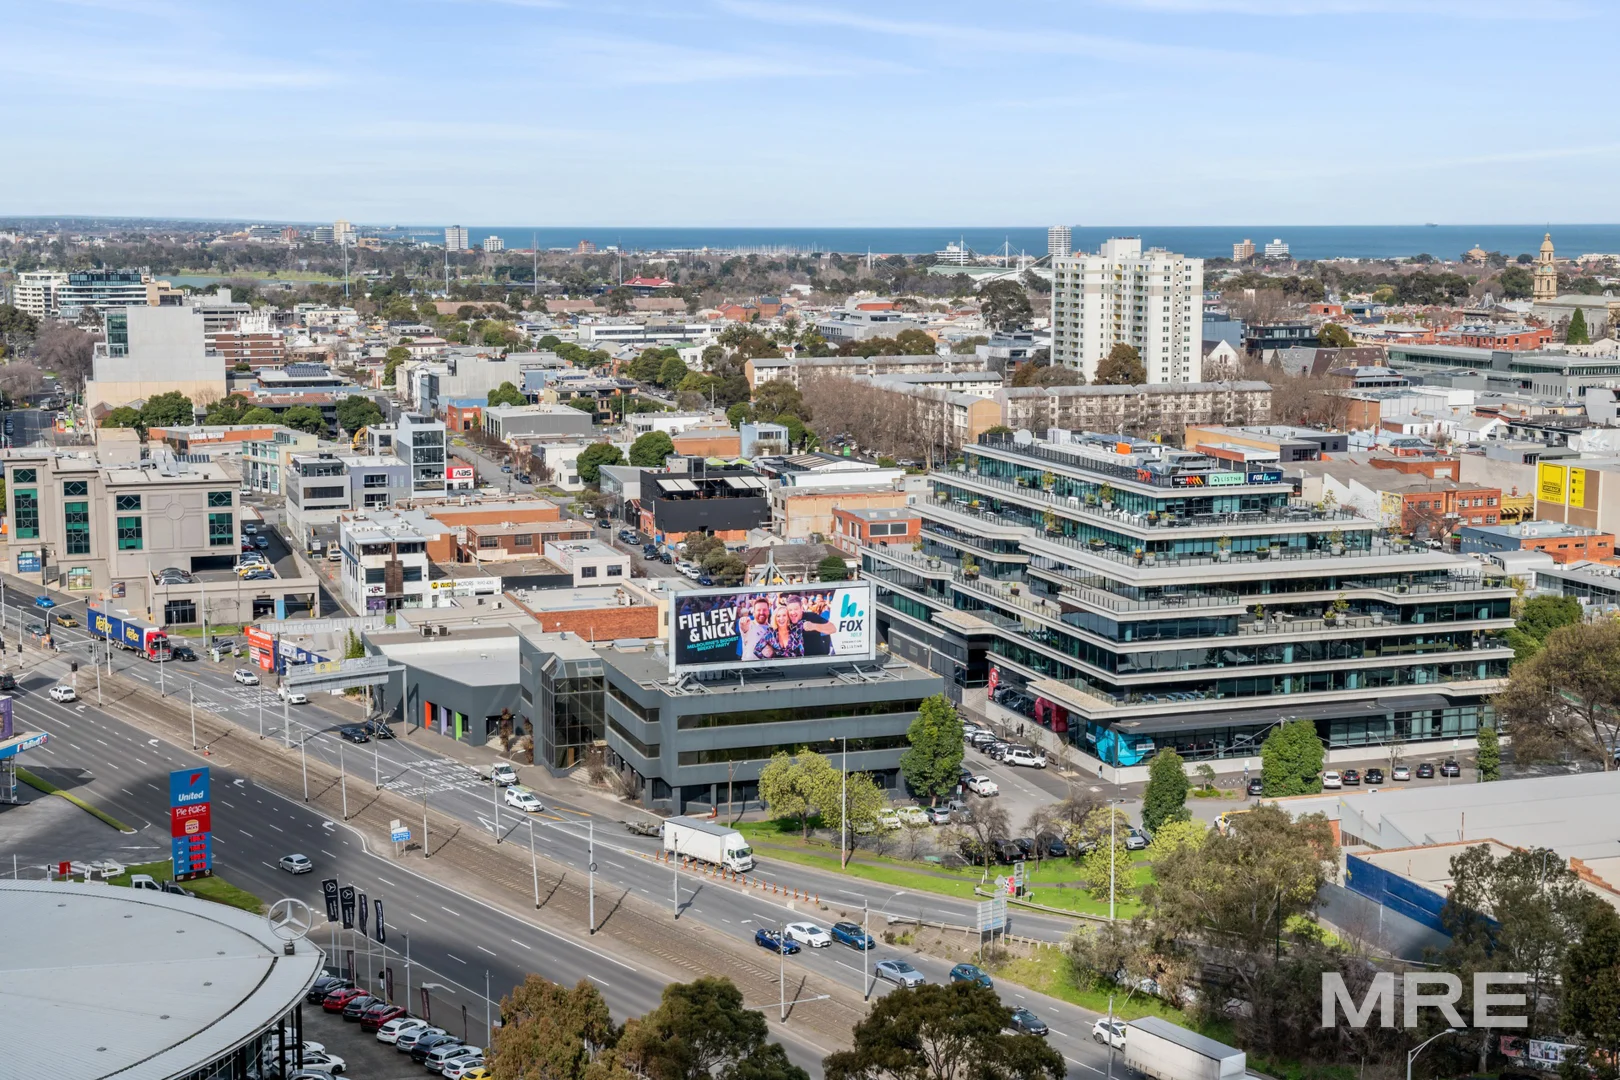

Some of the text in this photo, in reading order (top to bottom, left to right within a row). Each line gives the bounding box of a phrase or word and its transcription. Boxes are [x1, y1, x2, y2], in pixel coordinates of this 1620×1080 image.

[679, 606, 738, 630] FIFI, FEV
[690, 622, 736, 642] & NICK
[839, 620, 864, 632] FOX
[178, 790, 204, 802] United
[176, 805, 206, 817] Pie face
